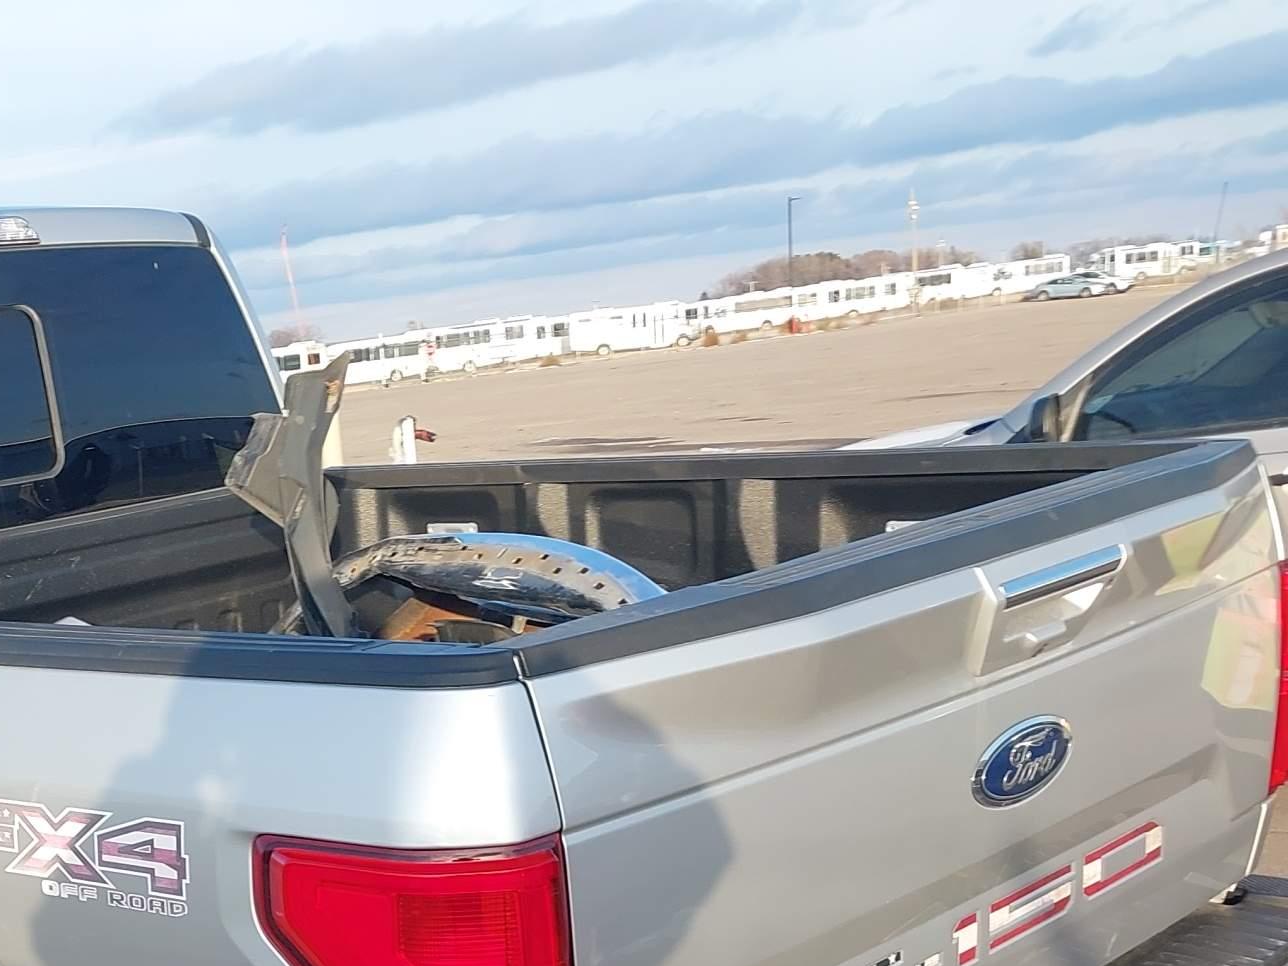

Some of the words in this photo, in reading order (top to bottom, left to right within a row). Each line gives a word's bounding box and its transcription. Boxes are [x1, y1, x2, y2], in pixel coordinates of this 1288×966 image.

[1002, 727, 1057, 791] Ford
[41, 879, 98, 901] OFF
[107, 890, 188, 917] ROAD
